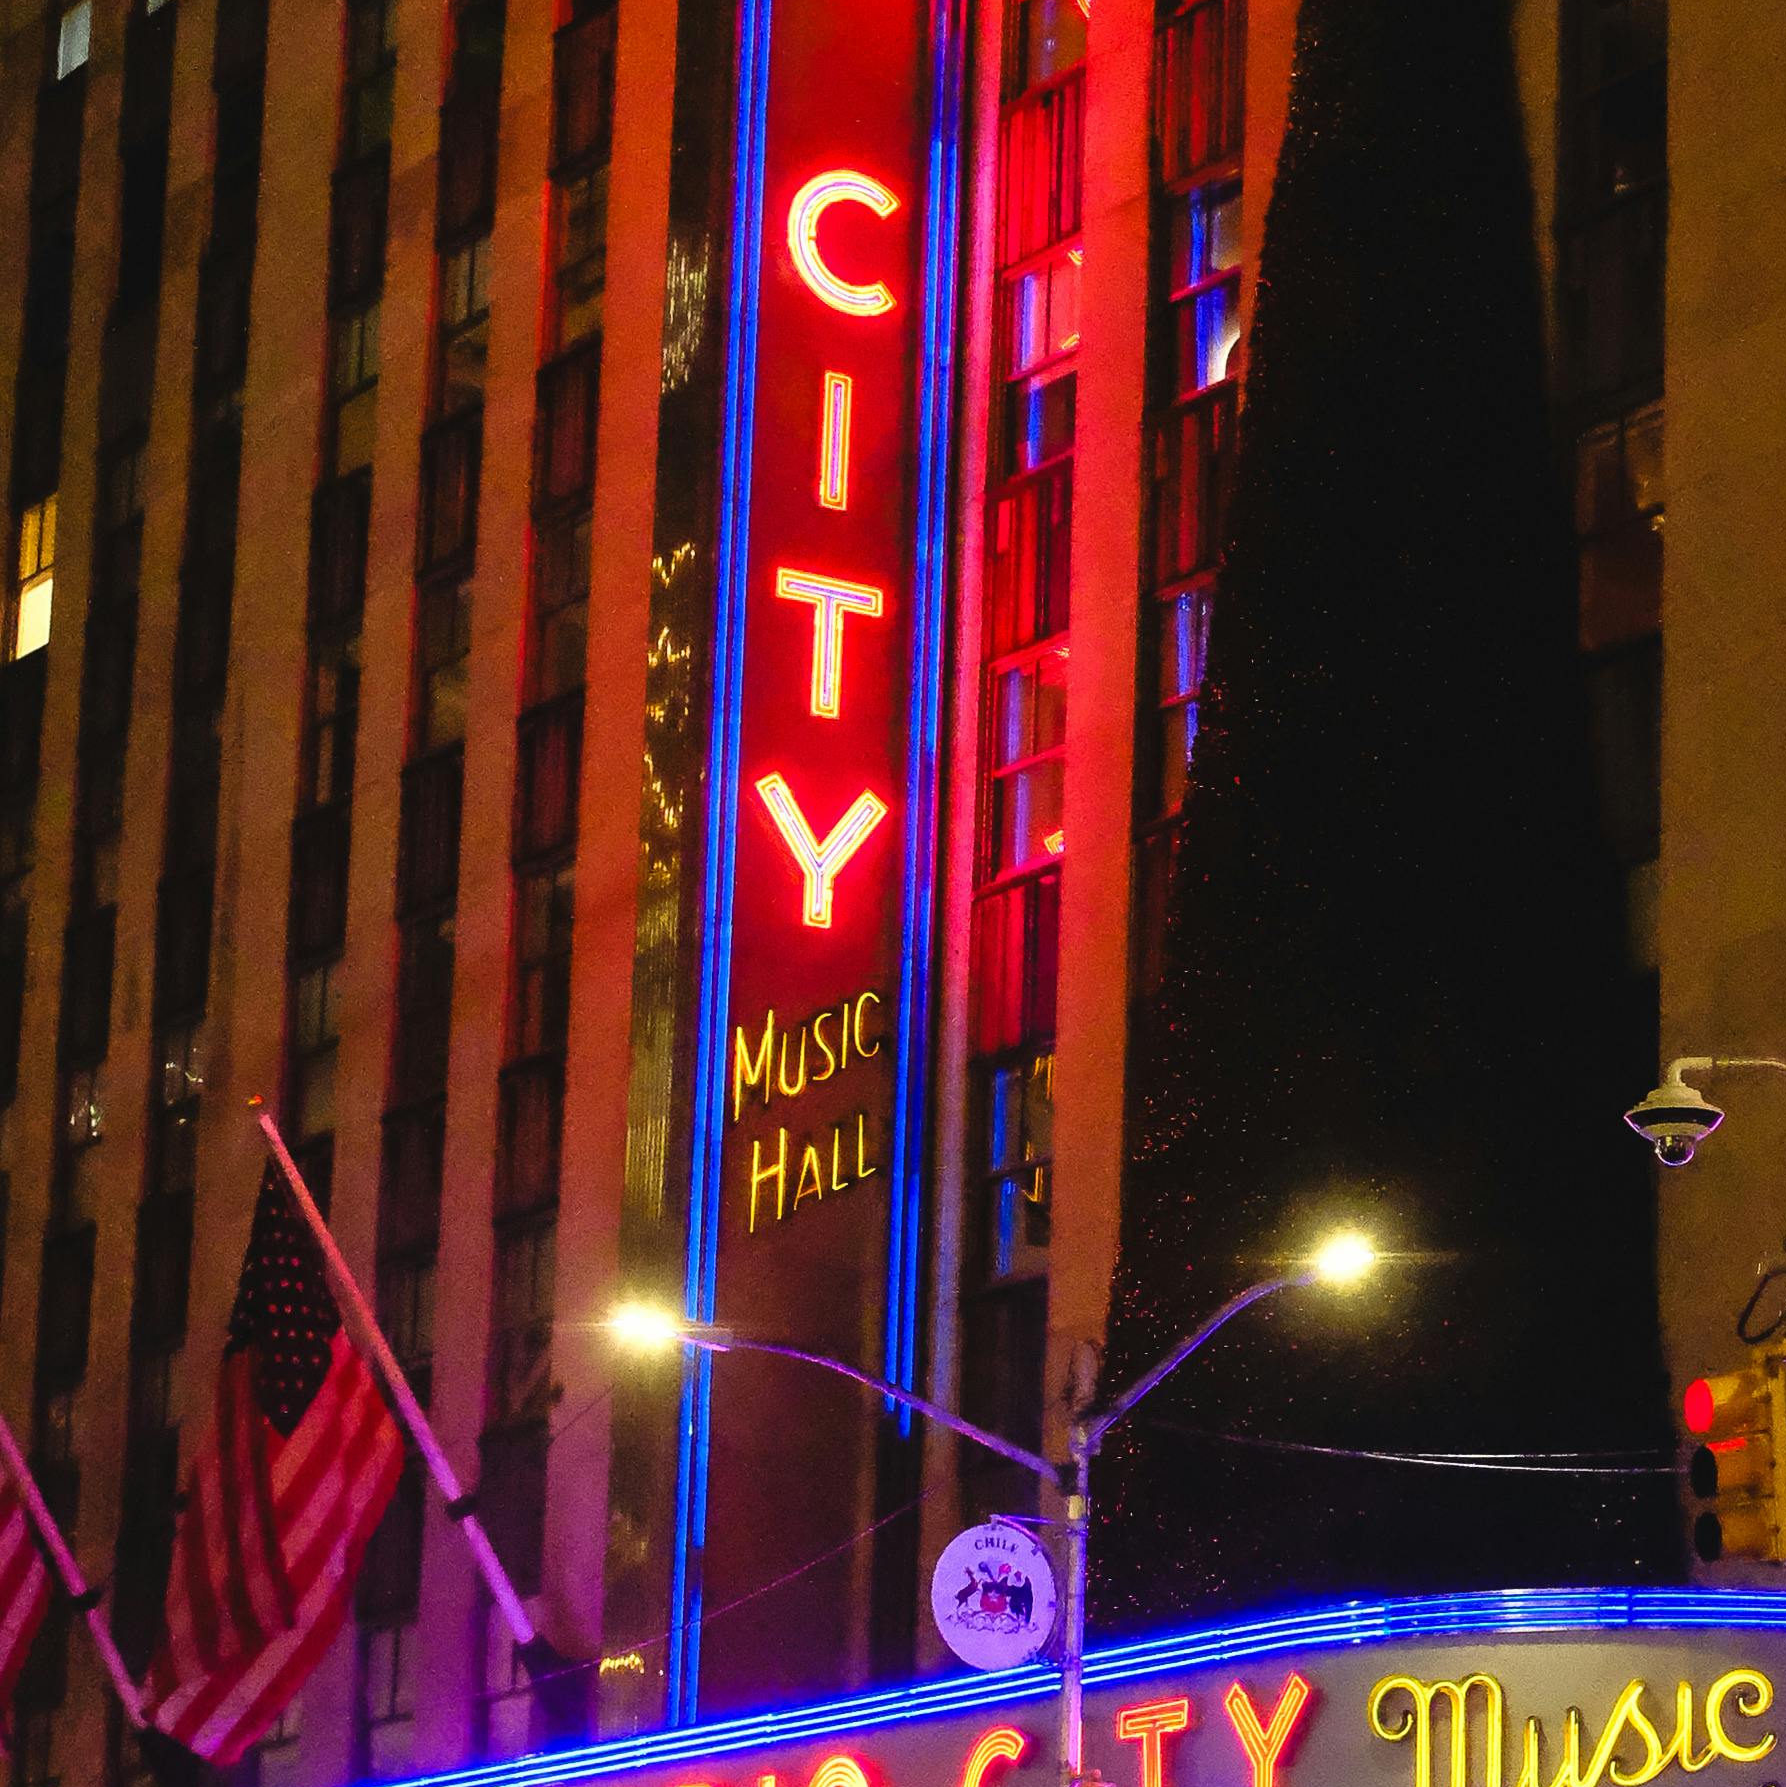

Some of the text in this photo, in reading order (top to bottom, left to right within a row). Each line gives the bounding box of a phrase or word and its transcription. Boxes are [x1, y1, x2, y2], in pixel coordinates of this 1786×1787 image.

[754, 169, 899, 929] CITY
[733, 992, 881, 1122] MUSIC
[749, 1140, 876, 1233] HALL
[974, 1536, 1019, 1553] CHILE
